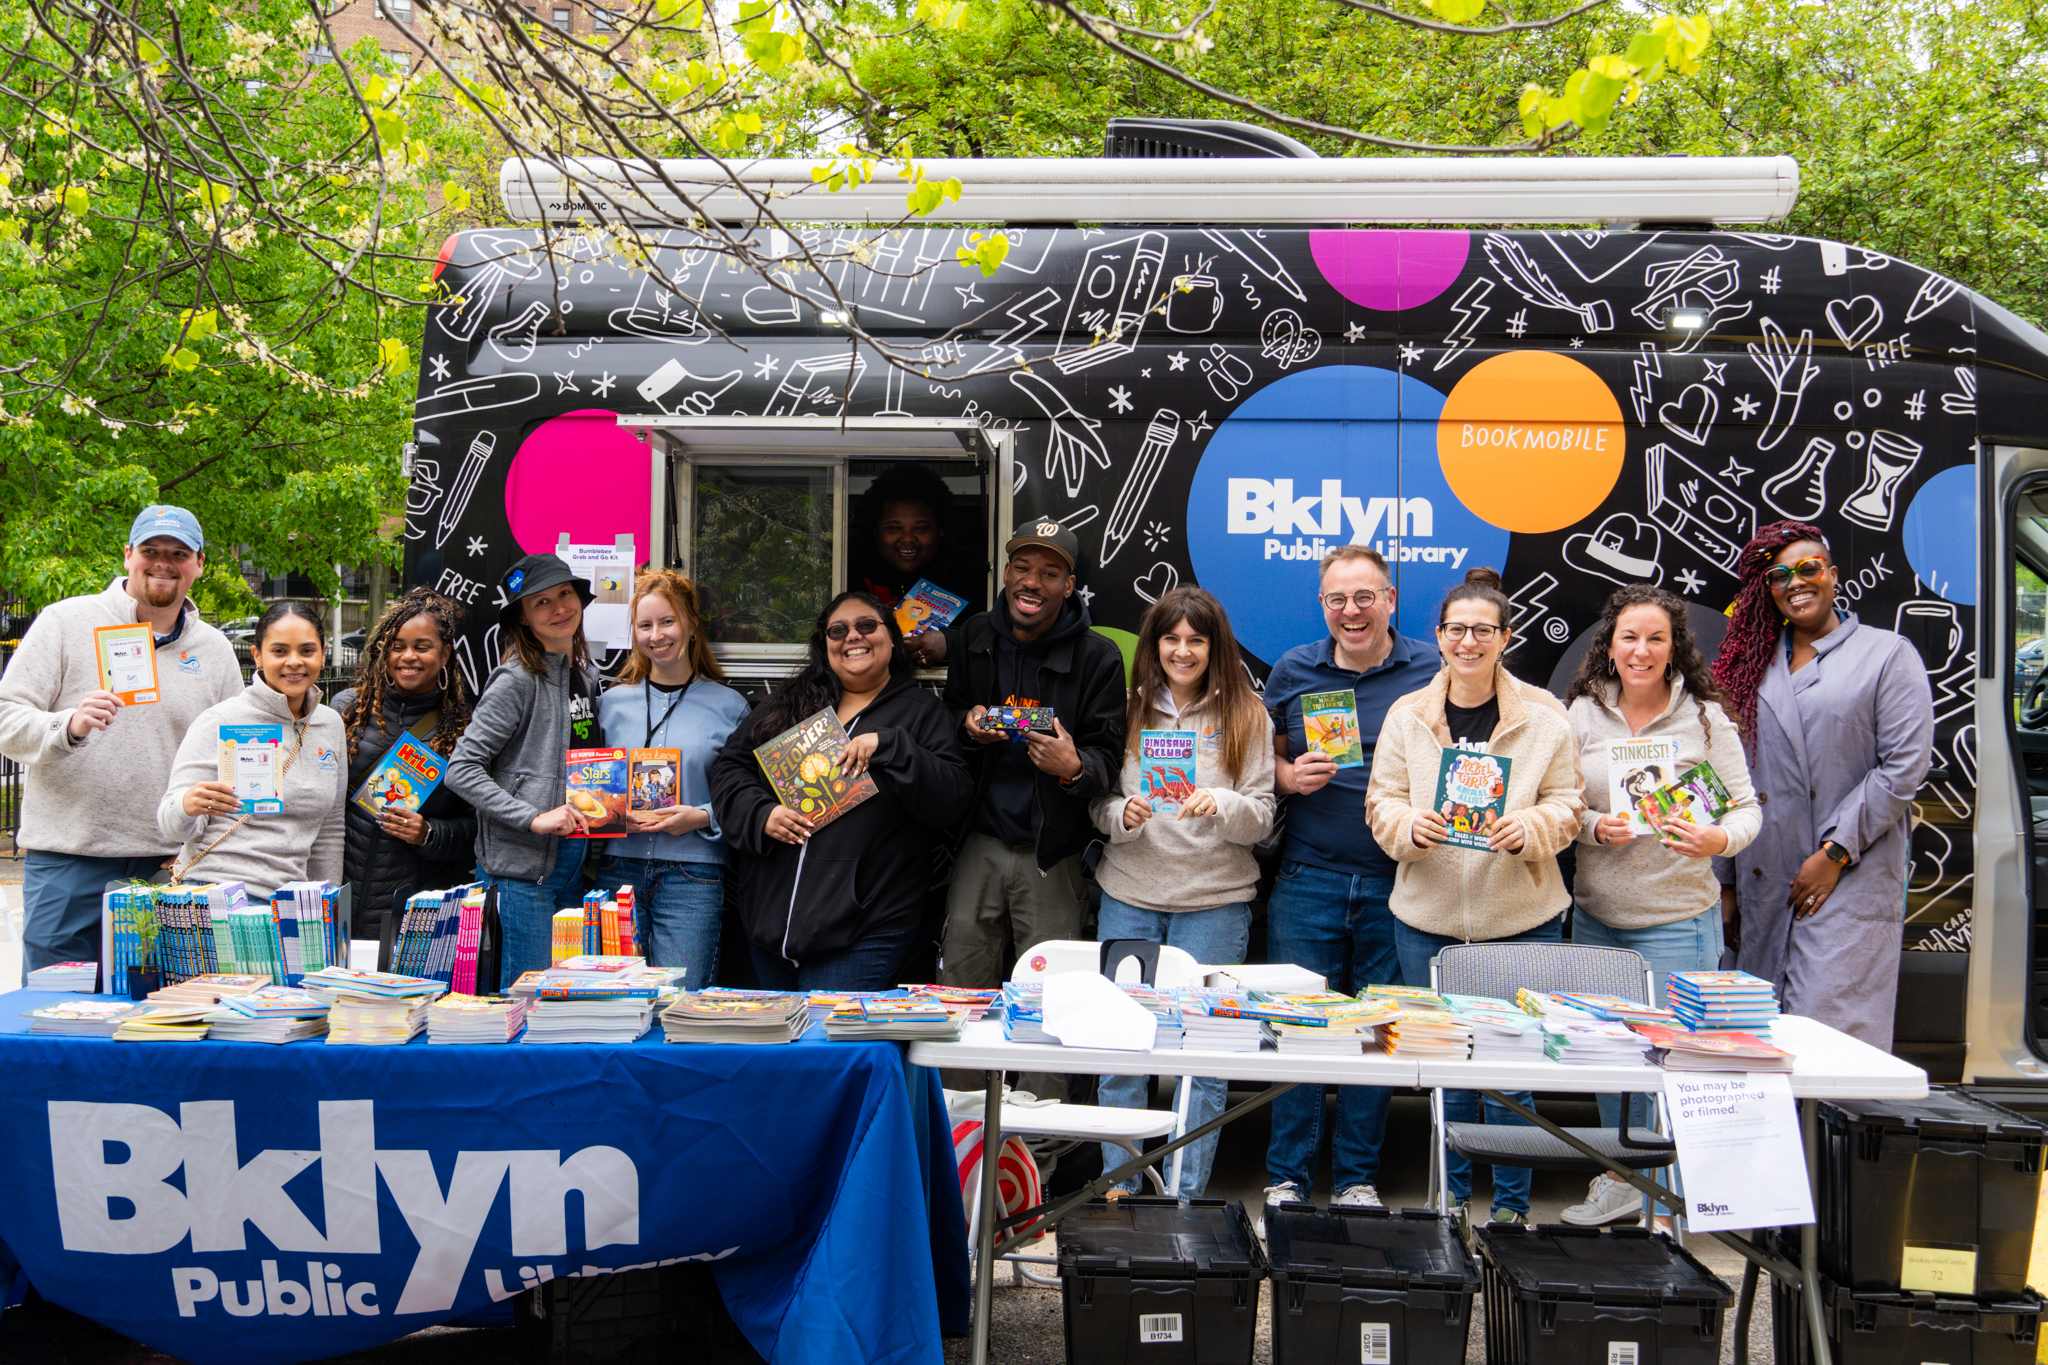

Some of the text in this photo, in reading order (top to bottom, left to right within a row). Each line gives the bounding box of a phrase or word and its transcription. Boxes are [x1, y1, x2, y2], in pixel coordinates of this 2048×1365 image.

[922, 334, 966, 373] FREE
[1864, 333, 1911, 372] FREE
[1461, 424, 1609, 451] BOOKMOBILE
[1227, 478, 1433, 547] Bklyn
[1376, 539, 1468, 569] Library
[435, 568, 486, 605] FREE
[914, 595, 950, 615] Scientist
[921, 592, 934, 601] Want
[761, 743, 781, 757] WHAT'S
[781, 732, 800, 746] INSIDE
[779, 717, 828, 778] FLOWER?
[1144, 738, 1195, 748] DINOSAUR
[633, 749, 677, 760] Ada Lace
[1154, 748, 1182, 757] CLUB
[1612, 744, 1669, 761] STINKIEST!
[582, 766, 610, 780] Stars
[1461, 759, 1494, 776] REBEL
[1457, 771, 1490, 789] GIRLS
[1456, 784, 1487, 796] ANIMAL
[1458, 794, 1483, 804] ALLIES
[1943, 908, 1972, 931] CARD
[1214, 1008, 1233, 1017] HiLo
[1677, 1081, 1746, 1093] You may be
[1680, 1091, 1764, 1107] photographed
[1682, 1105, 1738, 1118] or filmed.
[48, 1099, 639, 1315] Bklyn
[1697, 1203, 1729, 1215] Bklyn
[1931, 1271, 1943, 1280] 72
[171, 1260, 380, 1317] Public
[1150, 1332, 1172, 1340] B1734
